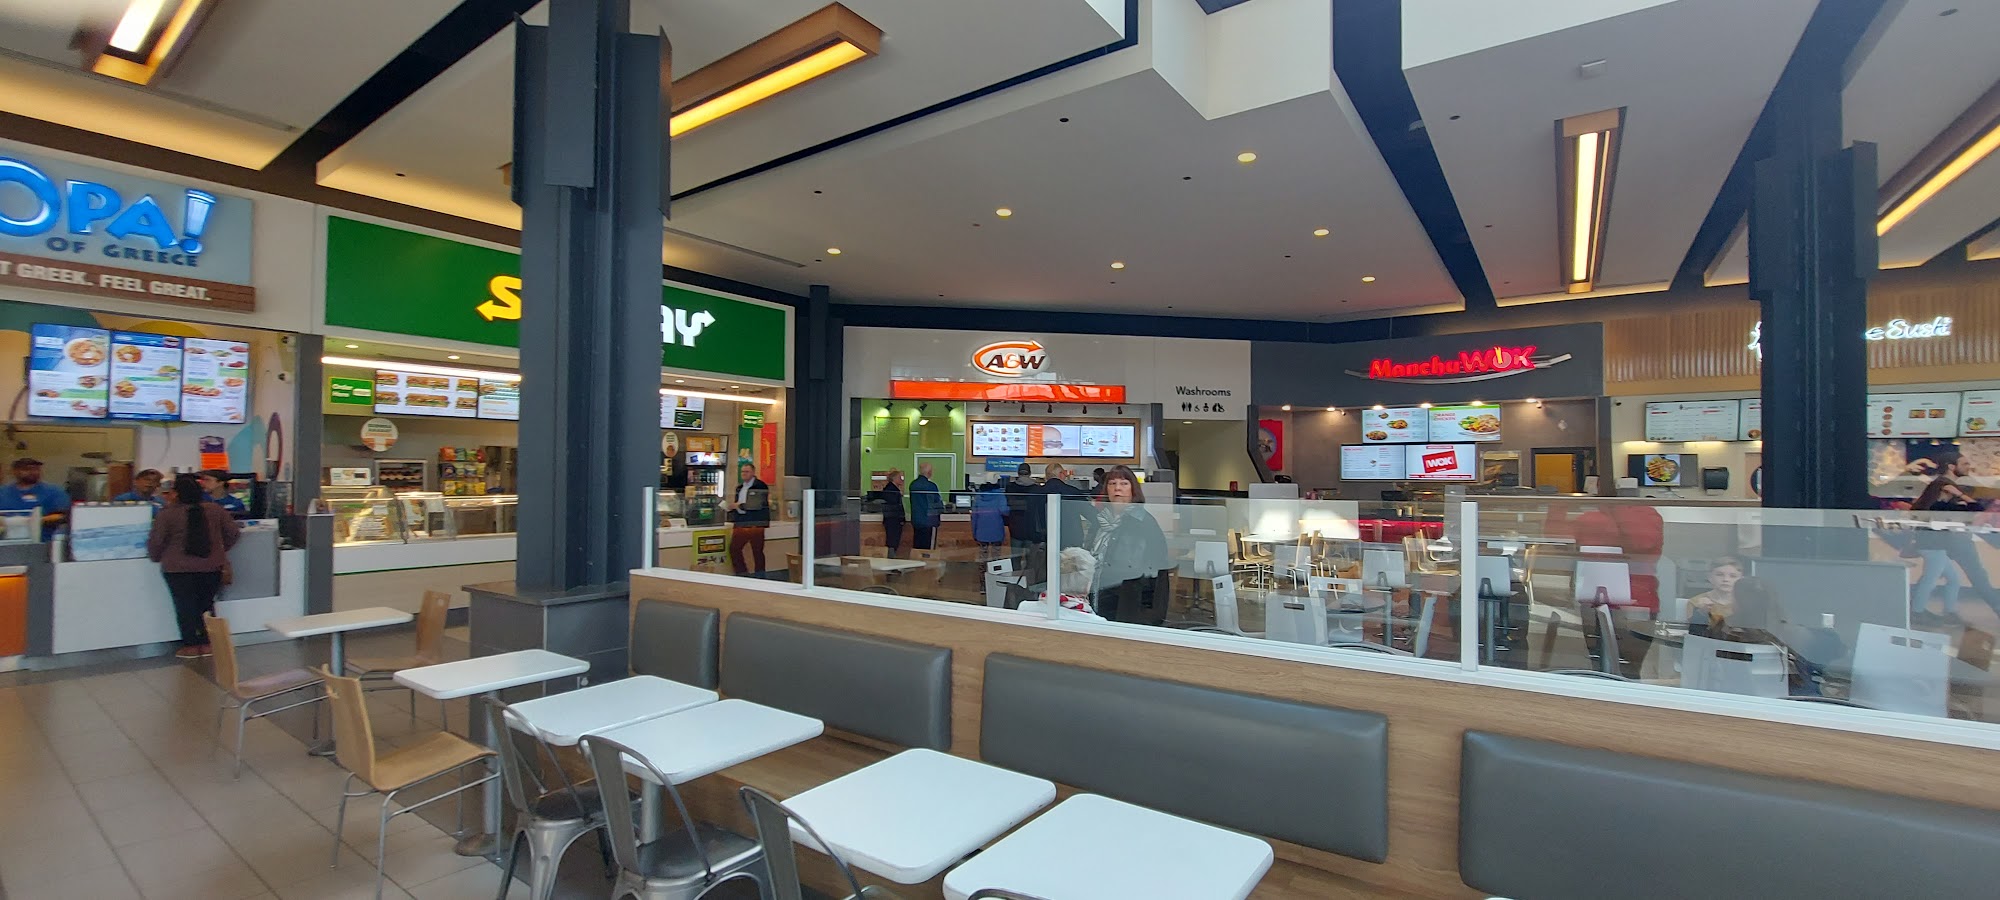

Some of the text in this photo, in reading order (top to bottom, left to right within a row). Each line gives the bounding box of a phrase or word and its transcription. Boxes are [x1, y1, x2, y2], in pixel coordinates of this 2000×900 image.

[0, 156, 216, 254] OPA!
[46, 236, 198, 267] OF GREECE
[16, 262, 95, 286] GREEK.
[99, 273, 147, 293] FEEL
[150, 280, 212, 301] GREAT.
[1884, 316, 1952, 340] Sushi
[986, 353, 1047, 370] A&W
[1175, 385, 1232, 396] Washrooms
